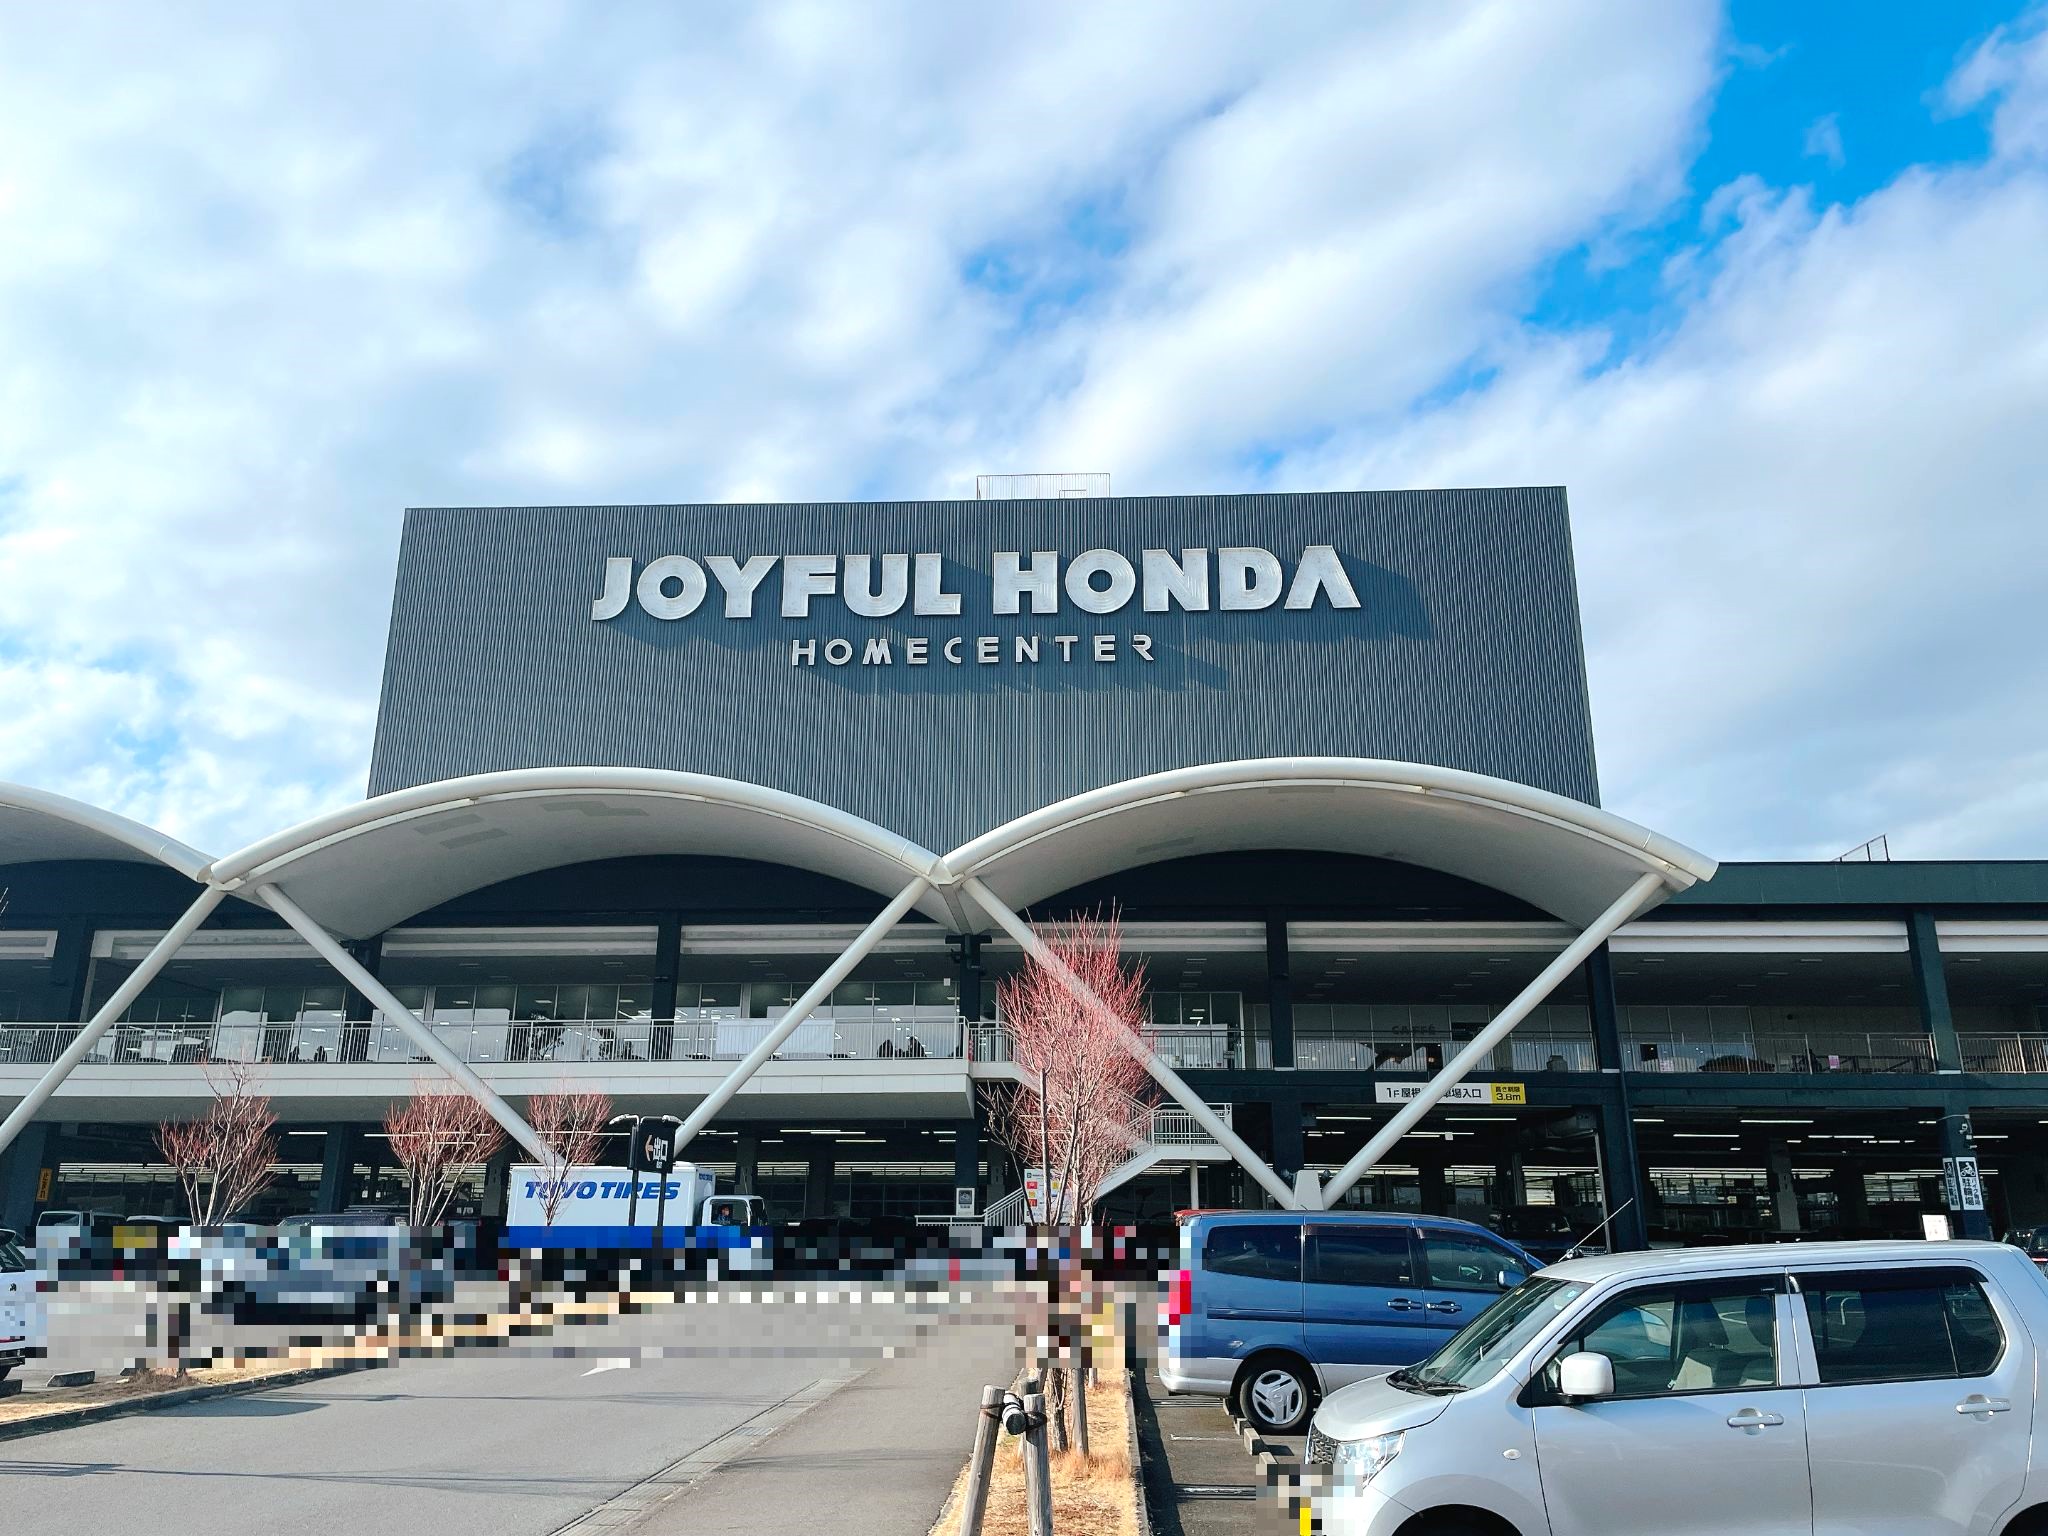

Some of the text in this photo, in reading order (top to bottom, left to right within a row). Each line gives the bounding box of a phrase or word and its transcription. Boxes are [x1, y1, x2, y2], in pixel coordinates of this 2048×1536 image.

[592, 545, 1361, 620] JOYFUL HONDA
[792, 634, 1154, 666] HOMECENTER
[653, 1137, 669, 1161] 出口
[601, 1181, 681, 1200] TIRES
